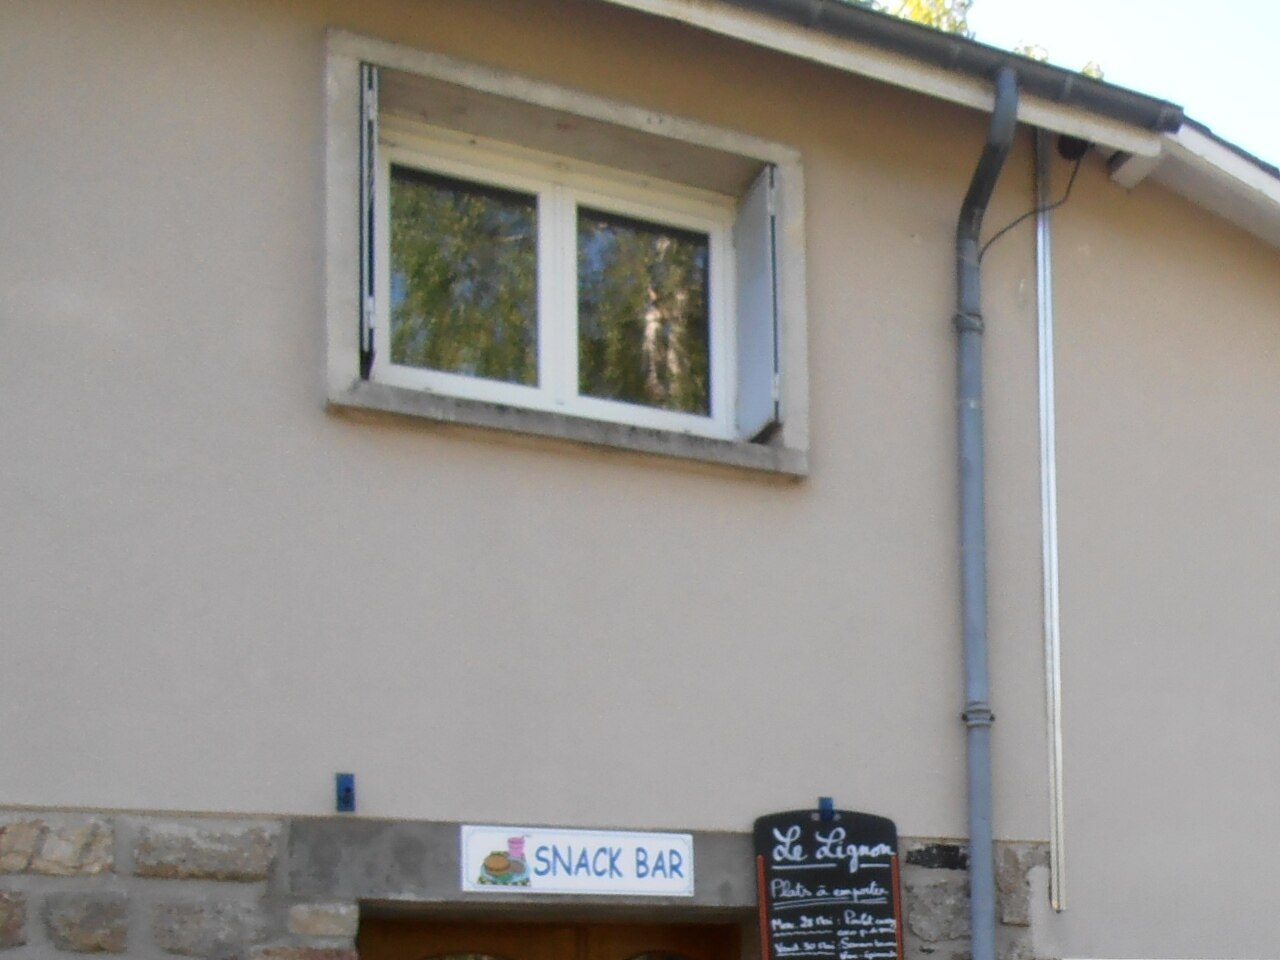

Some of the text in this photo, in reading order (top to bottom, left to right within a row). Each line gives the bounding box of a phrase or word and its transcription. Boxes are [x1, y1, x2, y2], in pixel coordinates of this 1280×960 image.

[533, 845, 684, 878] SNACK BAR
[773, 825, 897, 873] Le Lignon
[771, 879, 812, 898] Plats
[833, 881, 889, 903] emporter
